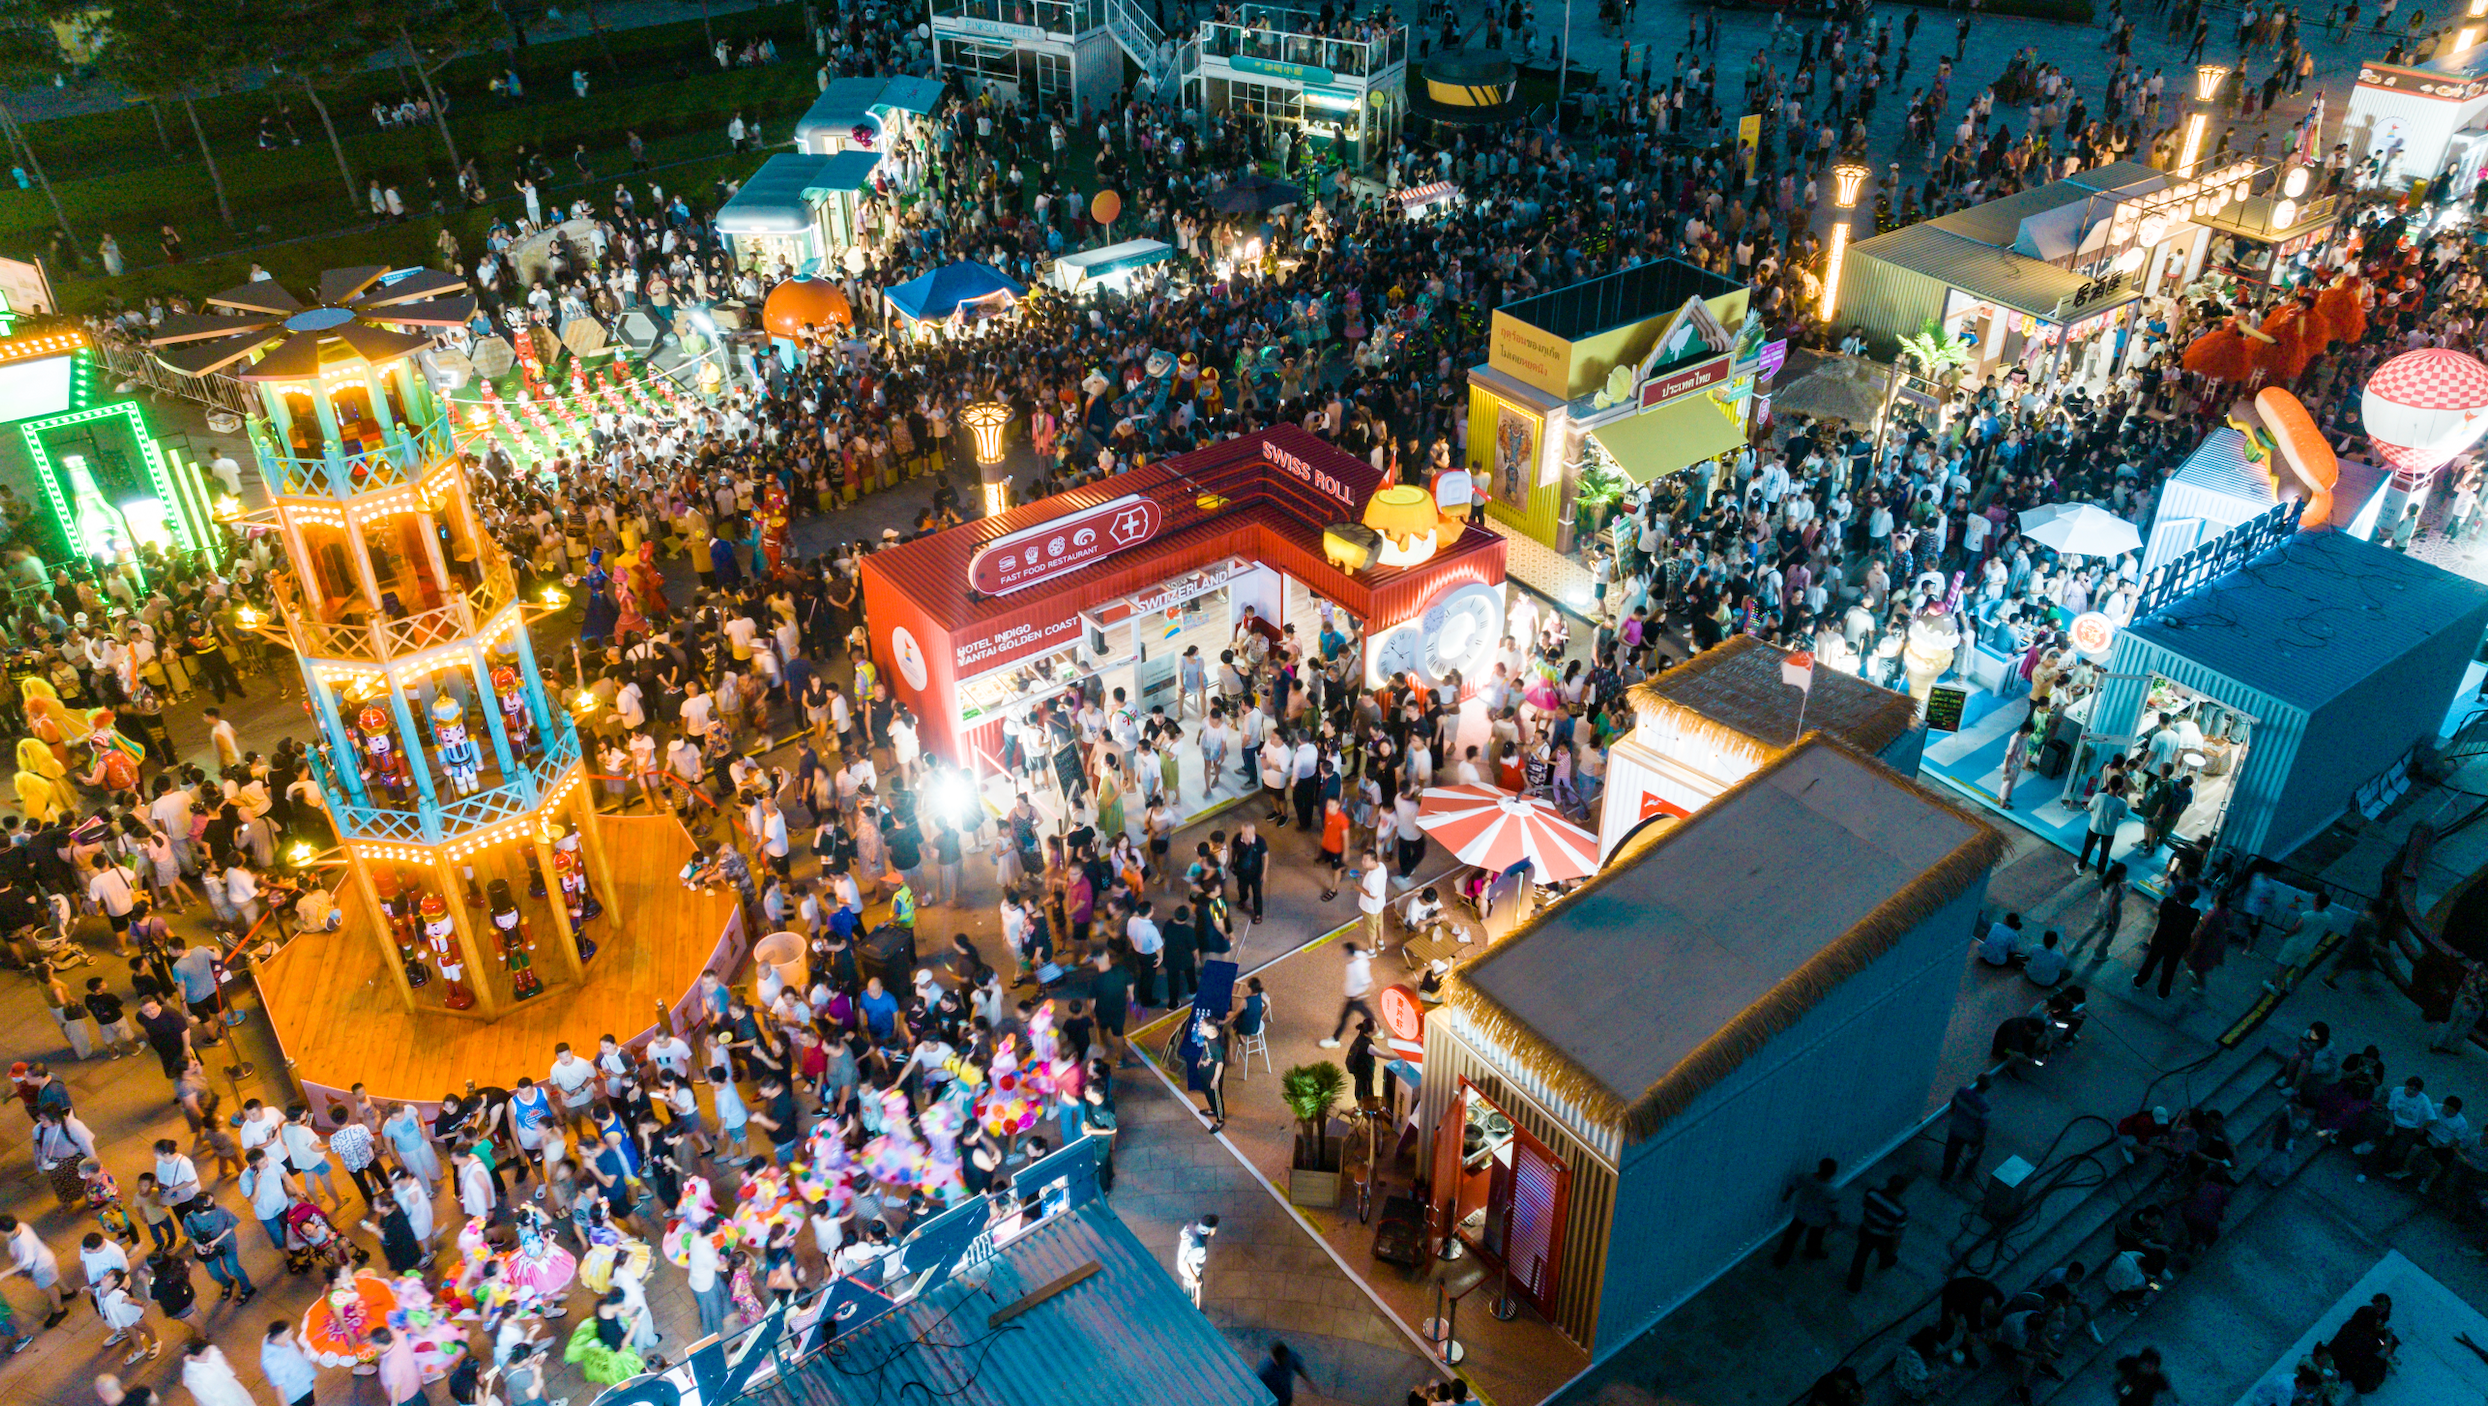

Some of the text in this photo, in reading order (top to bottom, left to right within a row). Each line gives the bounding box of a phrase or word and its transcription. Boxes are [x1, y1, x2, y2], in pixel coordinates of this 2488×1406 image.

[1003, 25, 1032, 38] COFFEE
[2072, 269, 2123, 308] 居酒屋
[1262, 440, 1354, 507] SWISS ROLL
[1000, 545, 1099, 585] FAST FOOD RESTAURANT
[1137, 570, 1228, 613] SWITZERLAND
[957, 623, 1031, 657] HOTEL INDIGO
[957, 616, 1078, 667] YANTAI GOLDEN COAST
